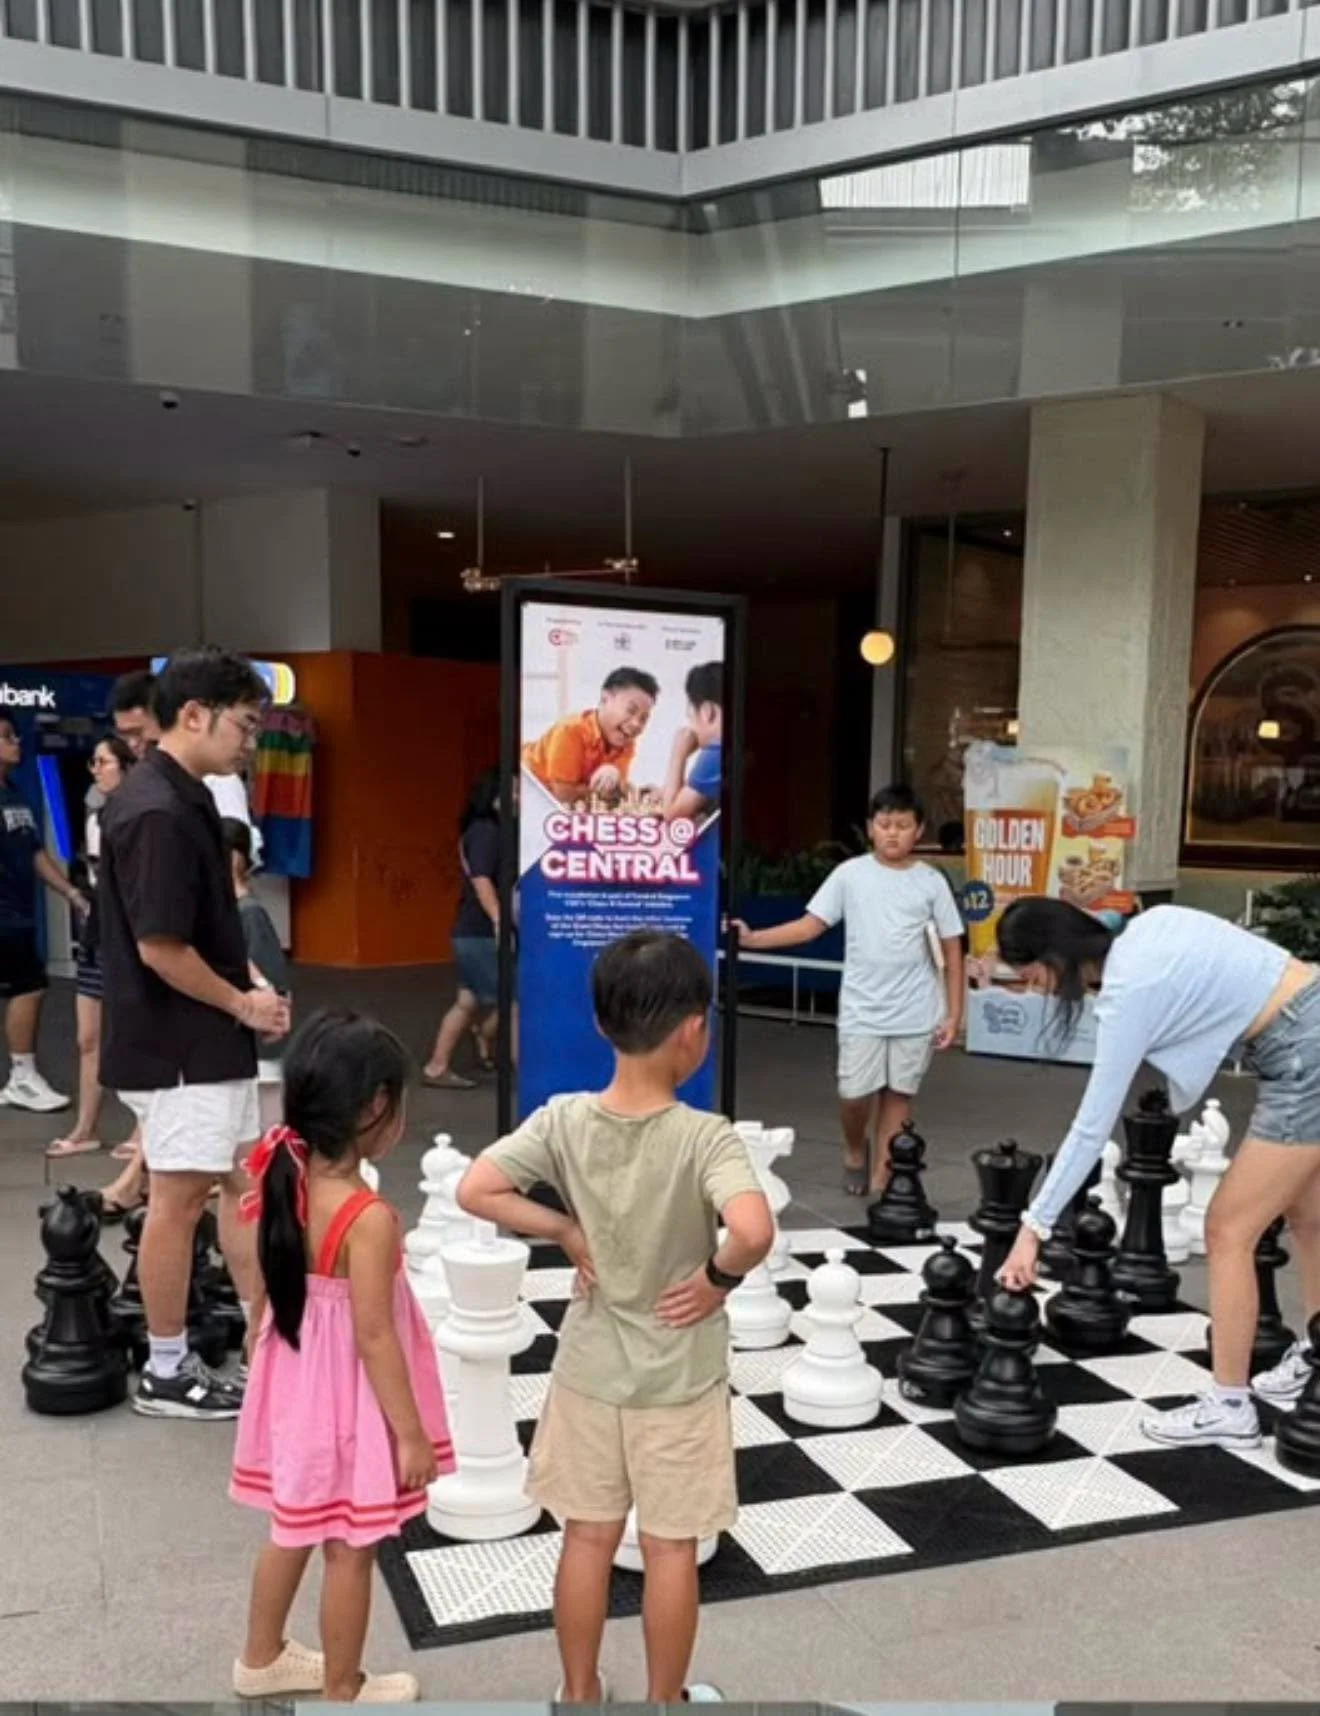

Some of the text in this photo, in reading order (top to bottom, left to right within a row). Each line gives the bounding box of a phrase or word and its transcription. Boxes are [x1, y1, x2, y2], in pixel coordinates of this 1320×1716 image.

[0, 682, 56, 708] bank
[545, 814, 695, 845] CHESS @
[974, 817, 1045, 850] GOLDEN
[540, 850, 699, 880] CENTRAL
[983, 852, 1032, 887] HOUR
